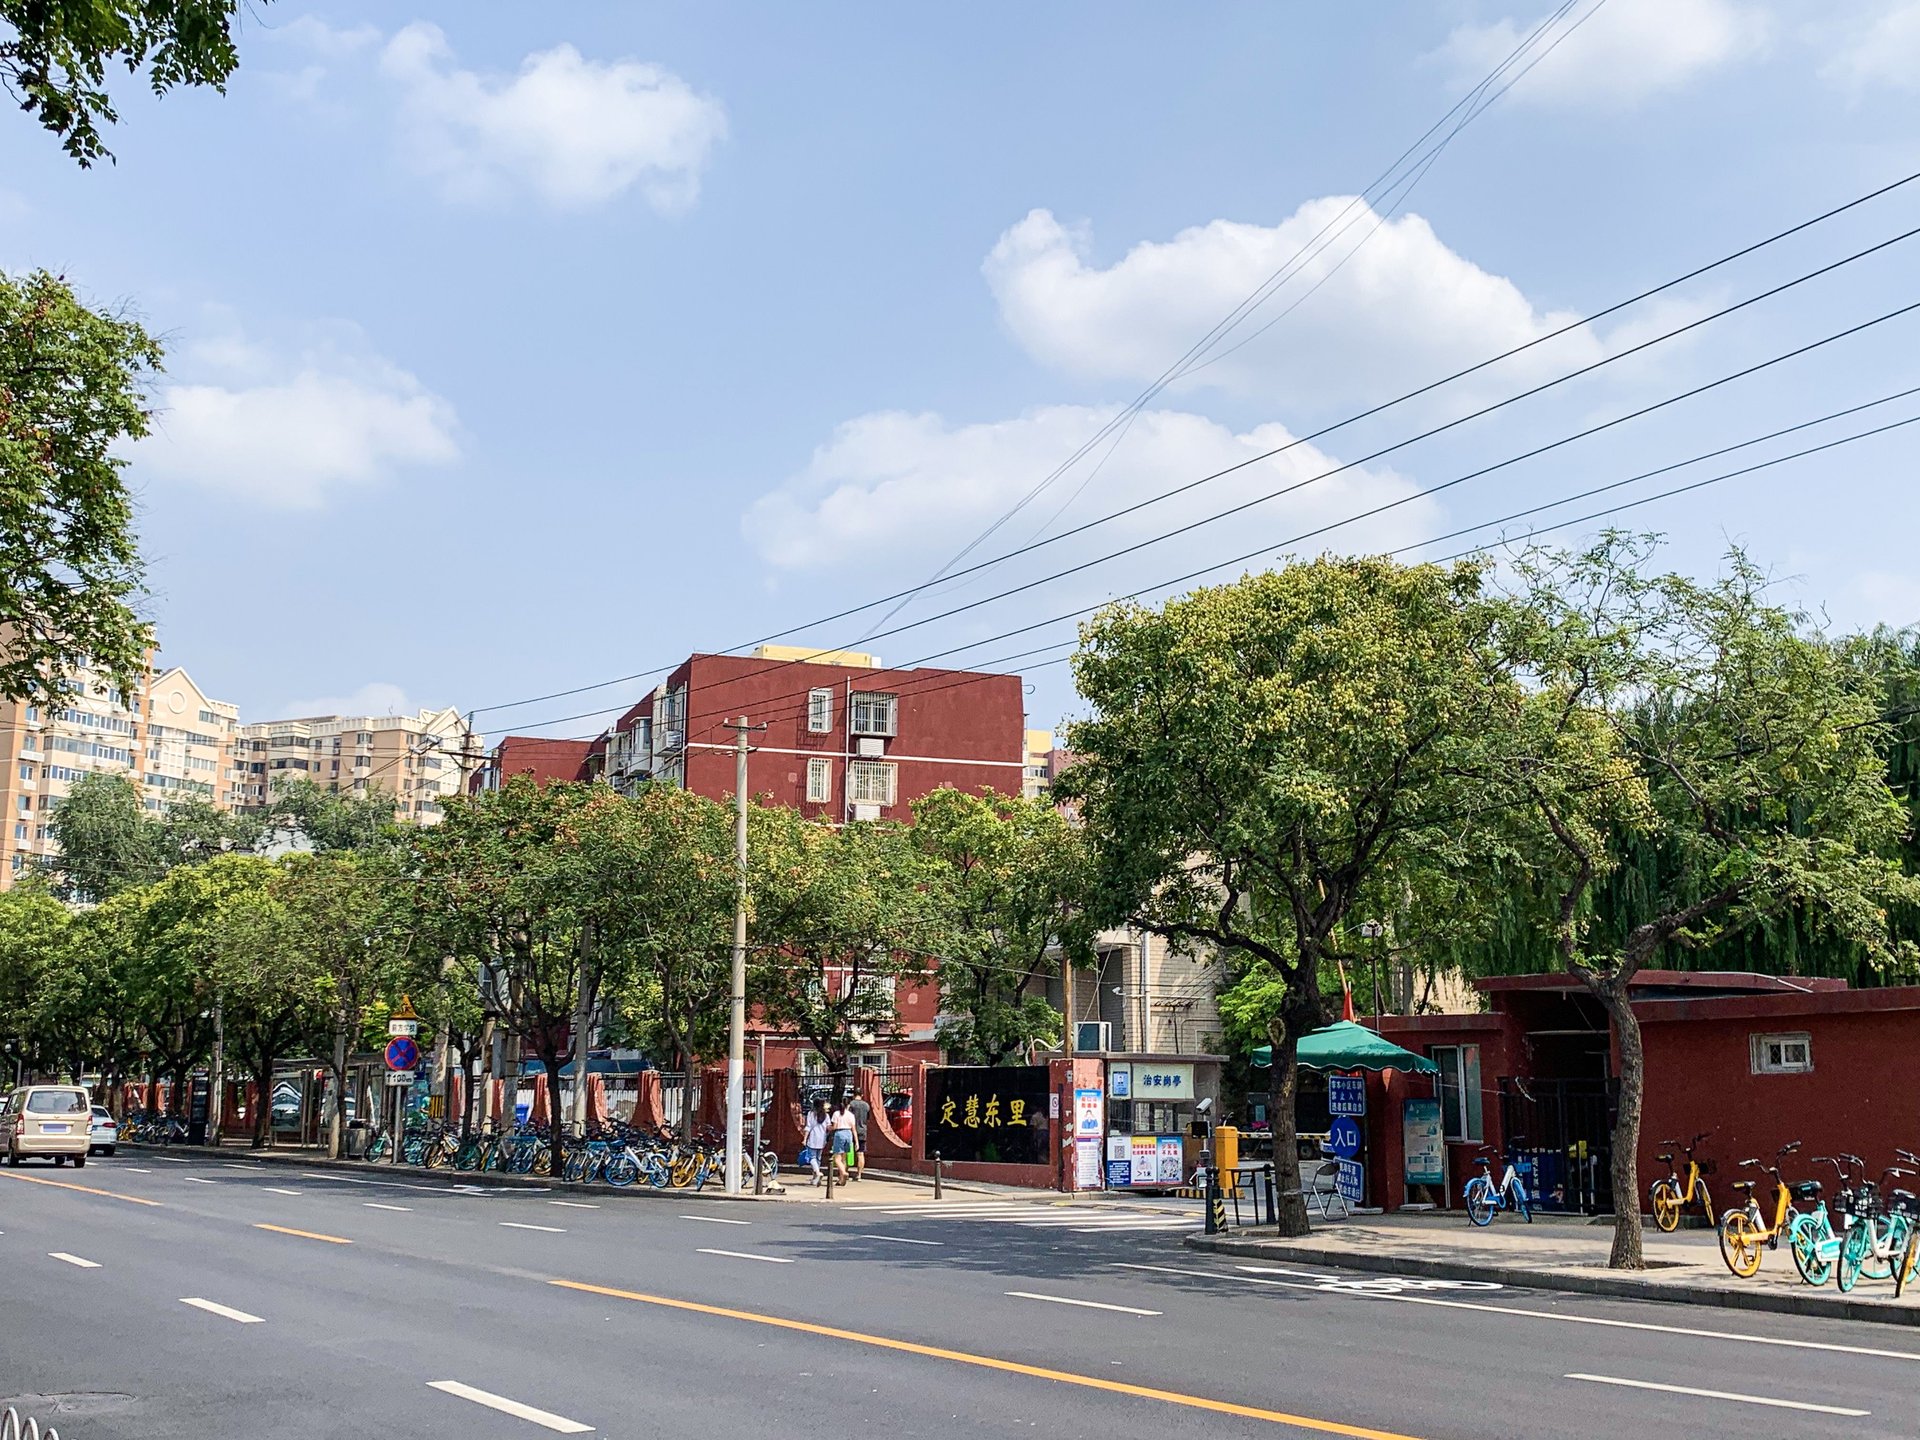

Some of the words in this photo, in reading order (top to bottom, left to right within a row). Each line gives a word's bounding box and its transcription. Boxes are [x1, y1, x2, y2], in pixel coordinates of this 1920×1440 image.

[1143, 1074, 1181, 1087] 治安岗亭
[940, 1093, 1027, 1128] 定慧东里
[1335, 1128, 1356, 1147] 入口
